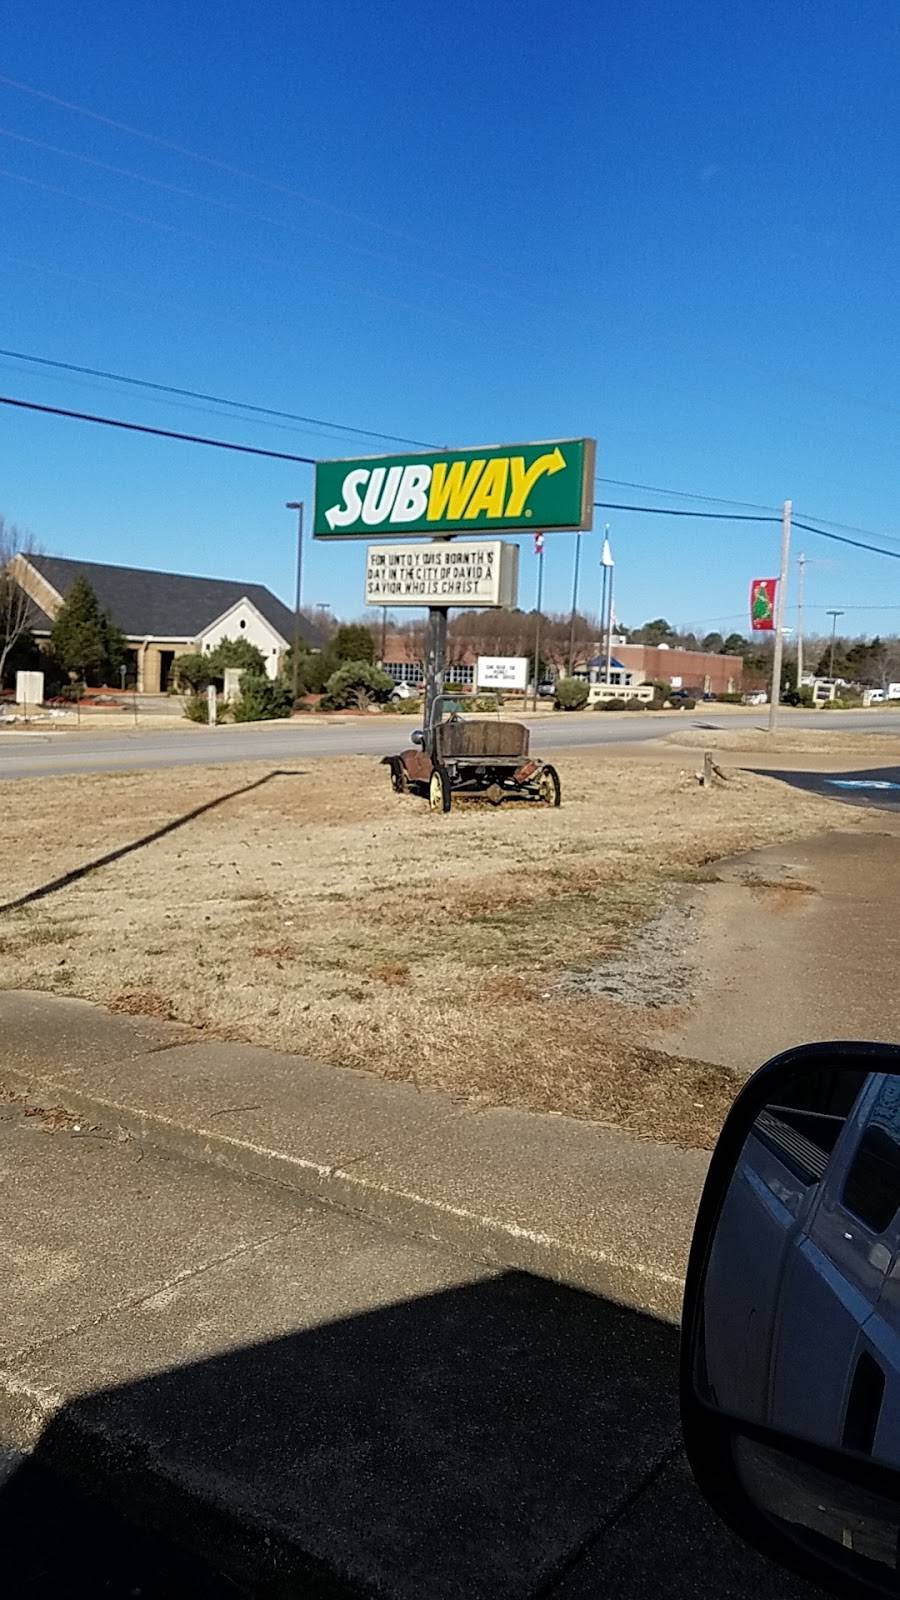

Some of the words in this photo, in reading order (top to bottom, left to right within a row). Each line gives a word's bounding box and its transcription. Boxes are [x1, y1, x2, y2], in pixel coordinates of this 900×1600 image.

[325, 447, 567, 530] SUBWAY
[370, 554, 386, 566] FOR
[388, 554, 413, 566] UNTO
[445, 552, 469, 565] BORN
[368, 569, 386, 580] DAY
[388, 568, 397, 579] IN
[400, 568, 414, 580] THE
[415, 567, 438, 580] CITY
[440, 567, 451, 579] OF
[453, 566, 482, 579] DAVID
[485, 567, 492, 580] A
[368, 582, 401, 594] SAVIOR
[405, 582, 425, 594] WHO
[427, 582, 438, 593] IS
[441, 581, 479, 593] CHRIST
